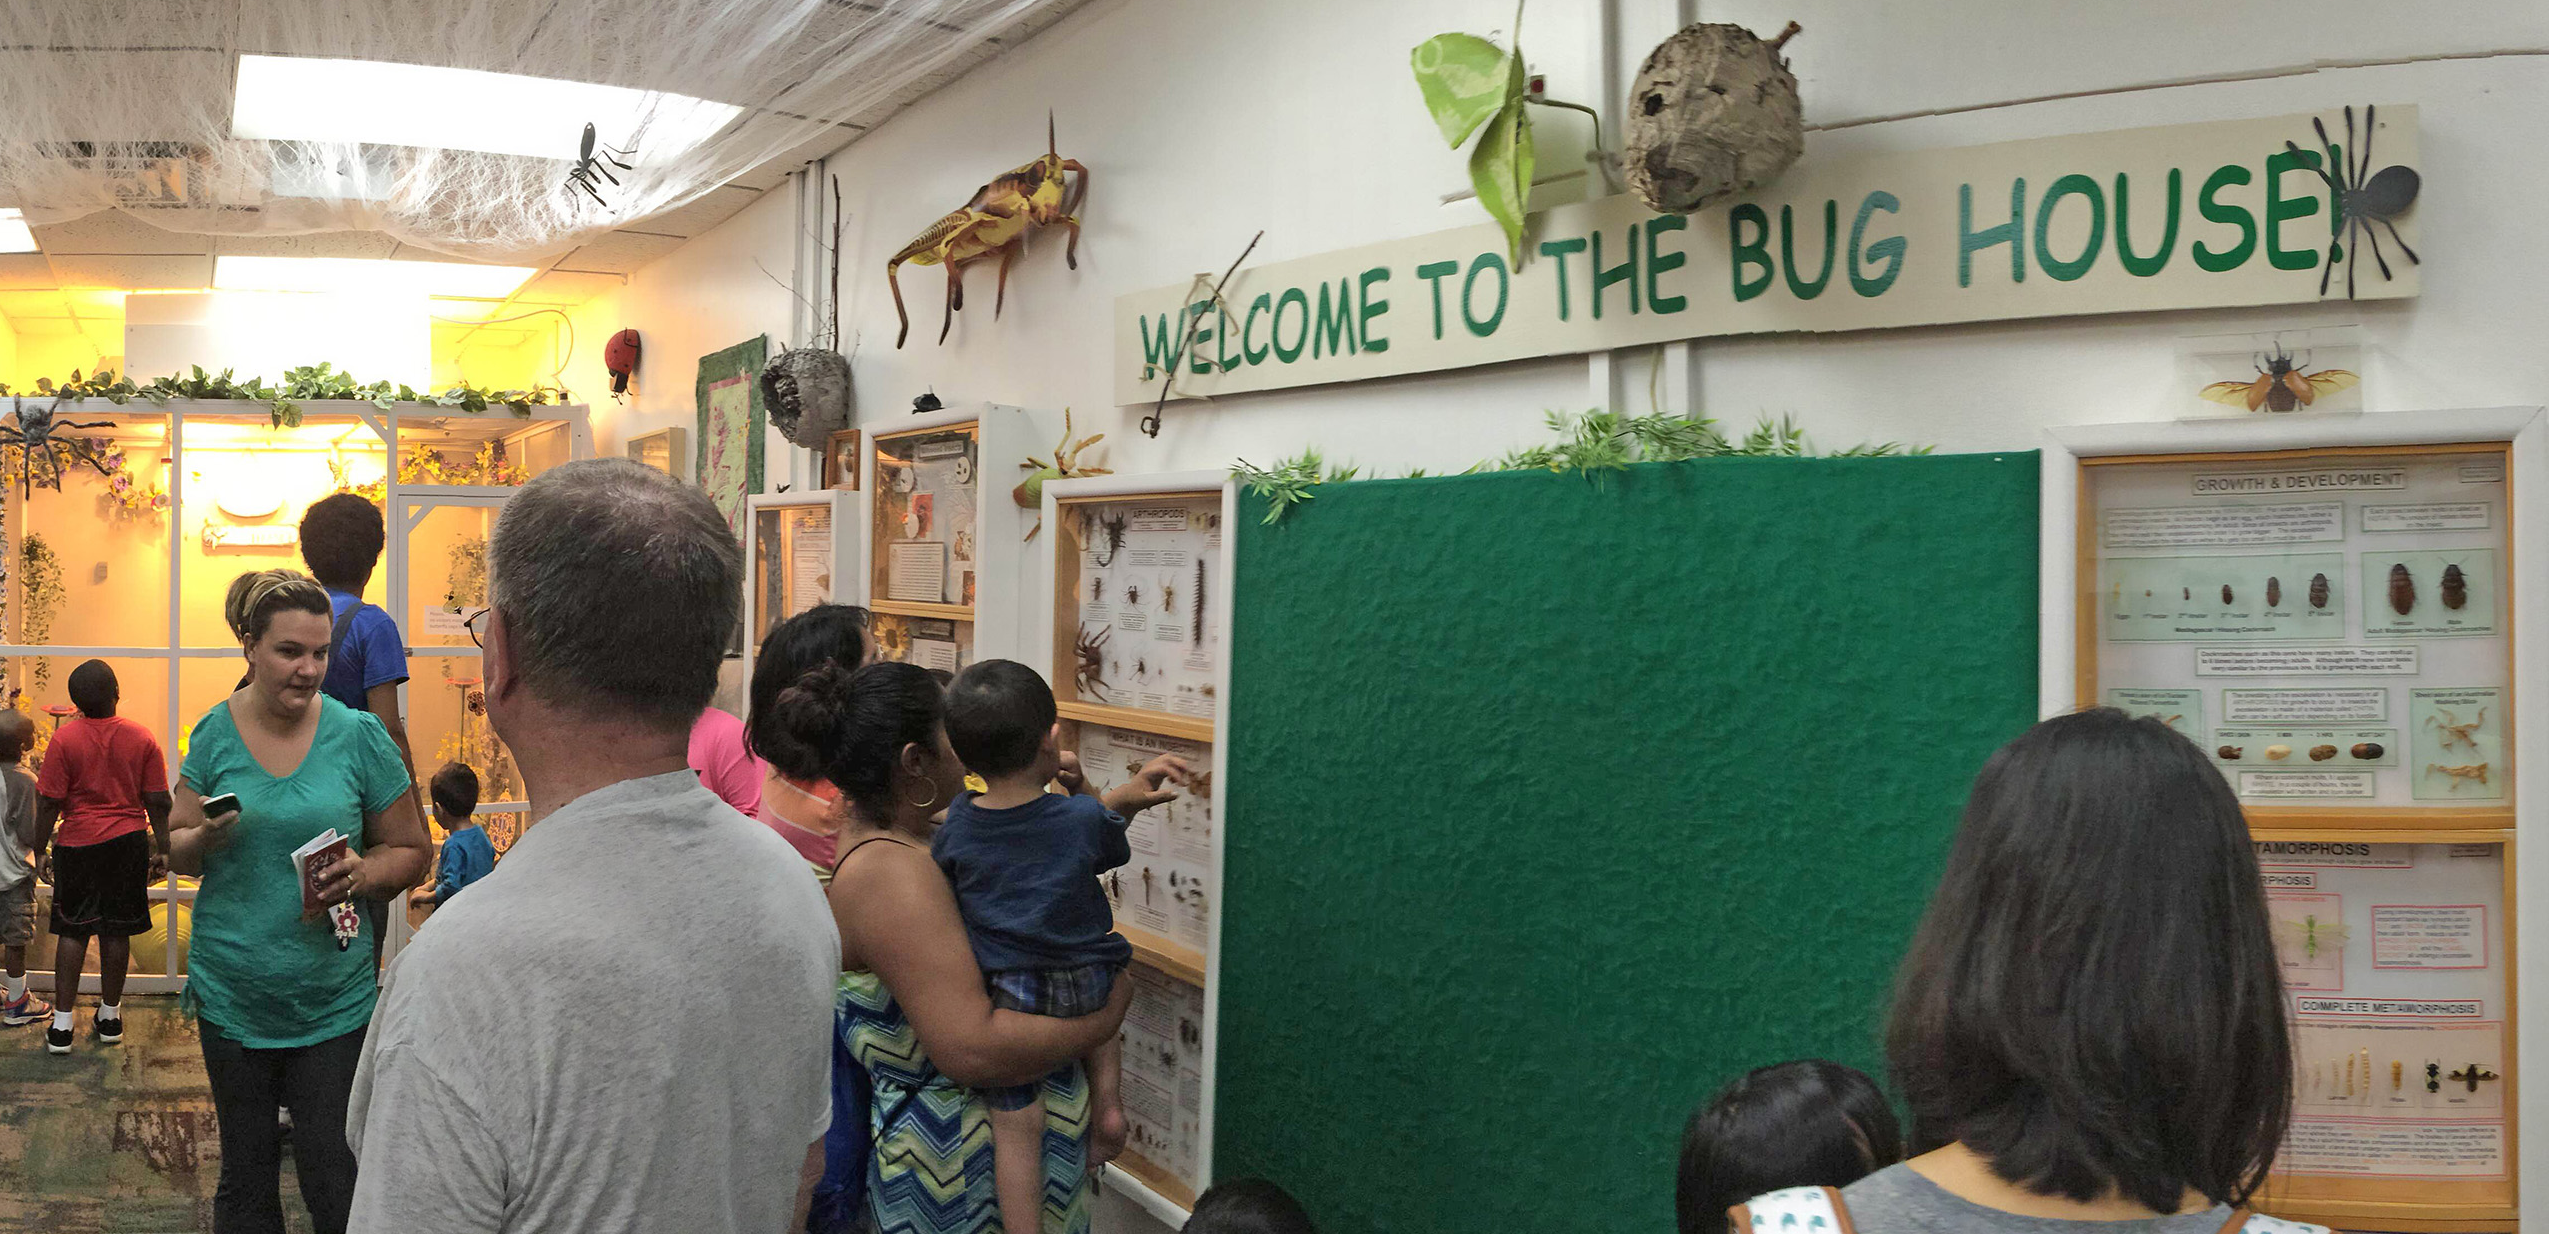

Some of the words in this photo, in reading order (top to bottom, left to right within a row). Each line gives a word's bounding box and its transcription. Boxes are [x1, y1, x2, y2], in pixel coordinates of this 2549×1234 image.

[1140, 267, 1391, 380] WELCOME
[1417, 252, 1508, 340] TO
[1539, 214, 1688, 322] THE
[1729, 190, 1908, 303] BUG
[2195, 477, 2265, 492] GROWTH
[2270, 477, 2280, 489] &
[2286, 472, 2404, 489] DEVELOPMENT
[1133, 509, 1184, 519] ARTHROPODS
[2254, 842, 2370, 856] TAMORPHOSIS
[2261, 875, 2312, 886] RPHOSIS
